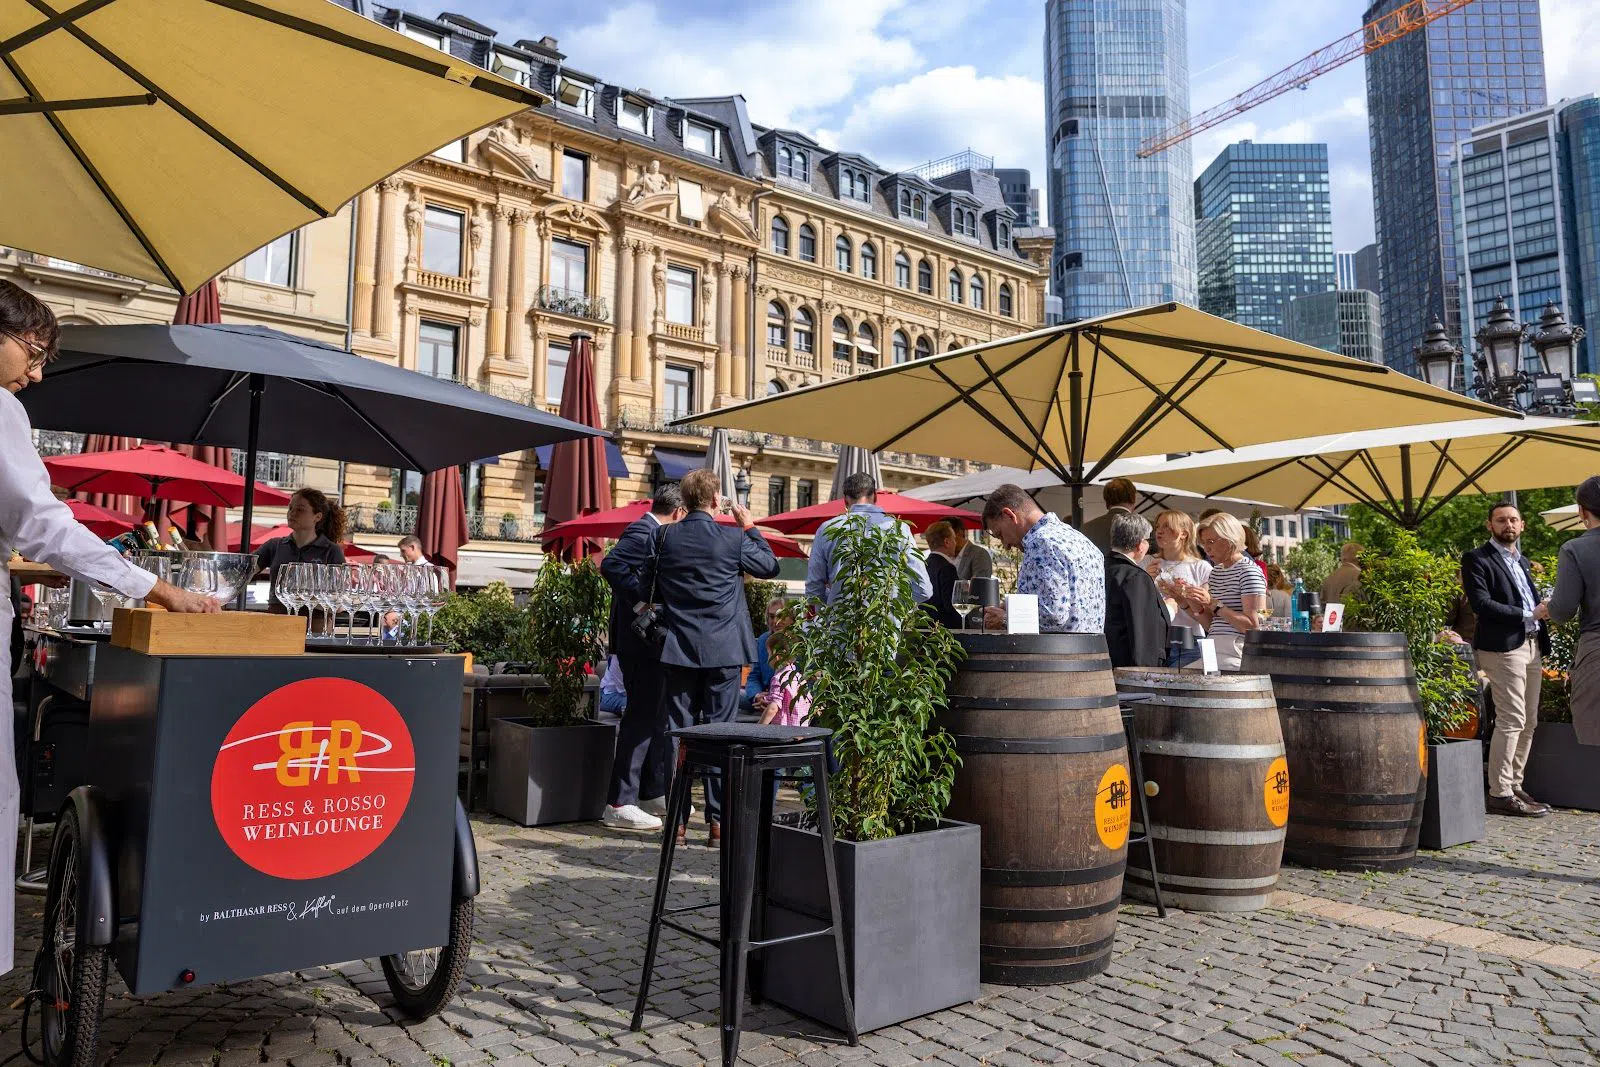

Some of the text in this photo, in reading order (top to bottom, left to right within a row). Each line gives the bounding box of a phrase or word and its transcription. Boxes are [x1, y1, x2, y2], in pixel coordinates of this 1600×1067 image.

[242, 794, 386, 820] RESS & ROSSO
[242, 814, 383, 841] WEINLOUNGE
[200, 913, 210, 923] by
[213, 905, 265, 921] BALTHASAR
[267, 902, 288, 914] RESS
[286, 901, 298, 921] &
[336, 905, 349, 915] auf
[351, 904, 366, 913] dem
[368, 899, 409, 912] Opernplatz
